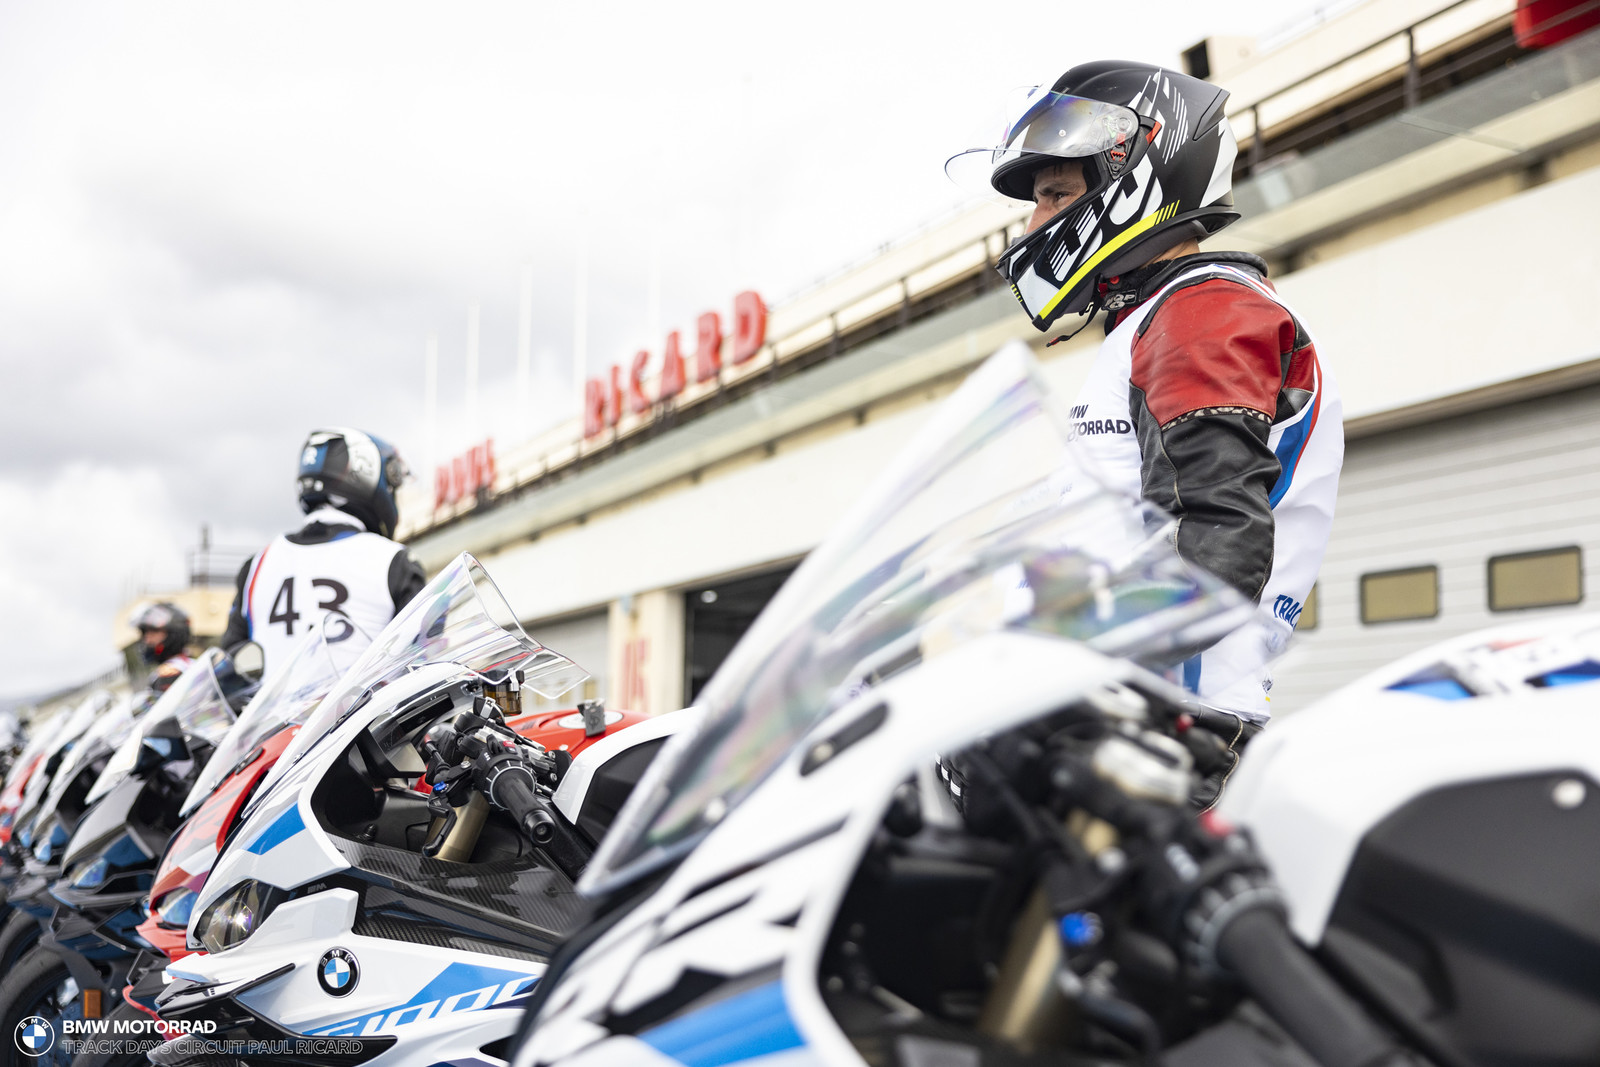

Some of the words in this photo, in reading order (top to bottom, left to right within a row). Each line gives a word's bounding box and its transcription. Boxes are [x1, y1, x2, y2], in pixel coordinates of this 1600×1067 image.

[584, 290, 768, 440] RICARD
[1069, 404, 1089, 419] MW
[269, 577, 354, 643] 43
[321, 950, 353, 967] BMW
